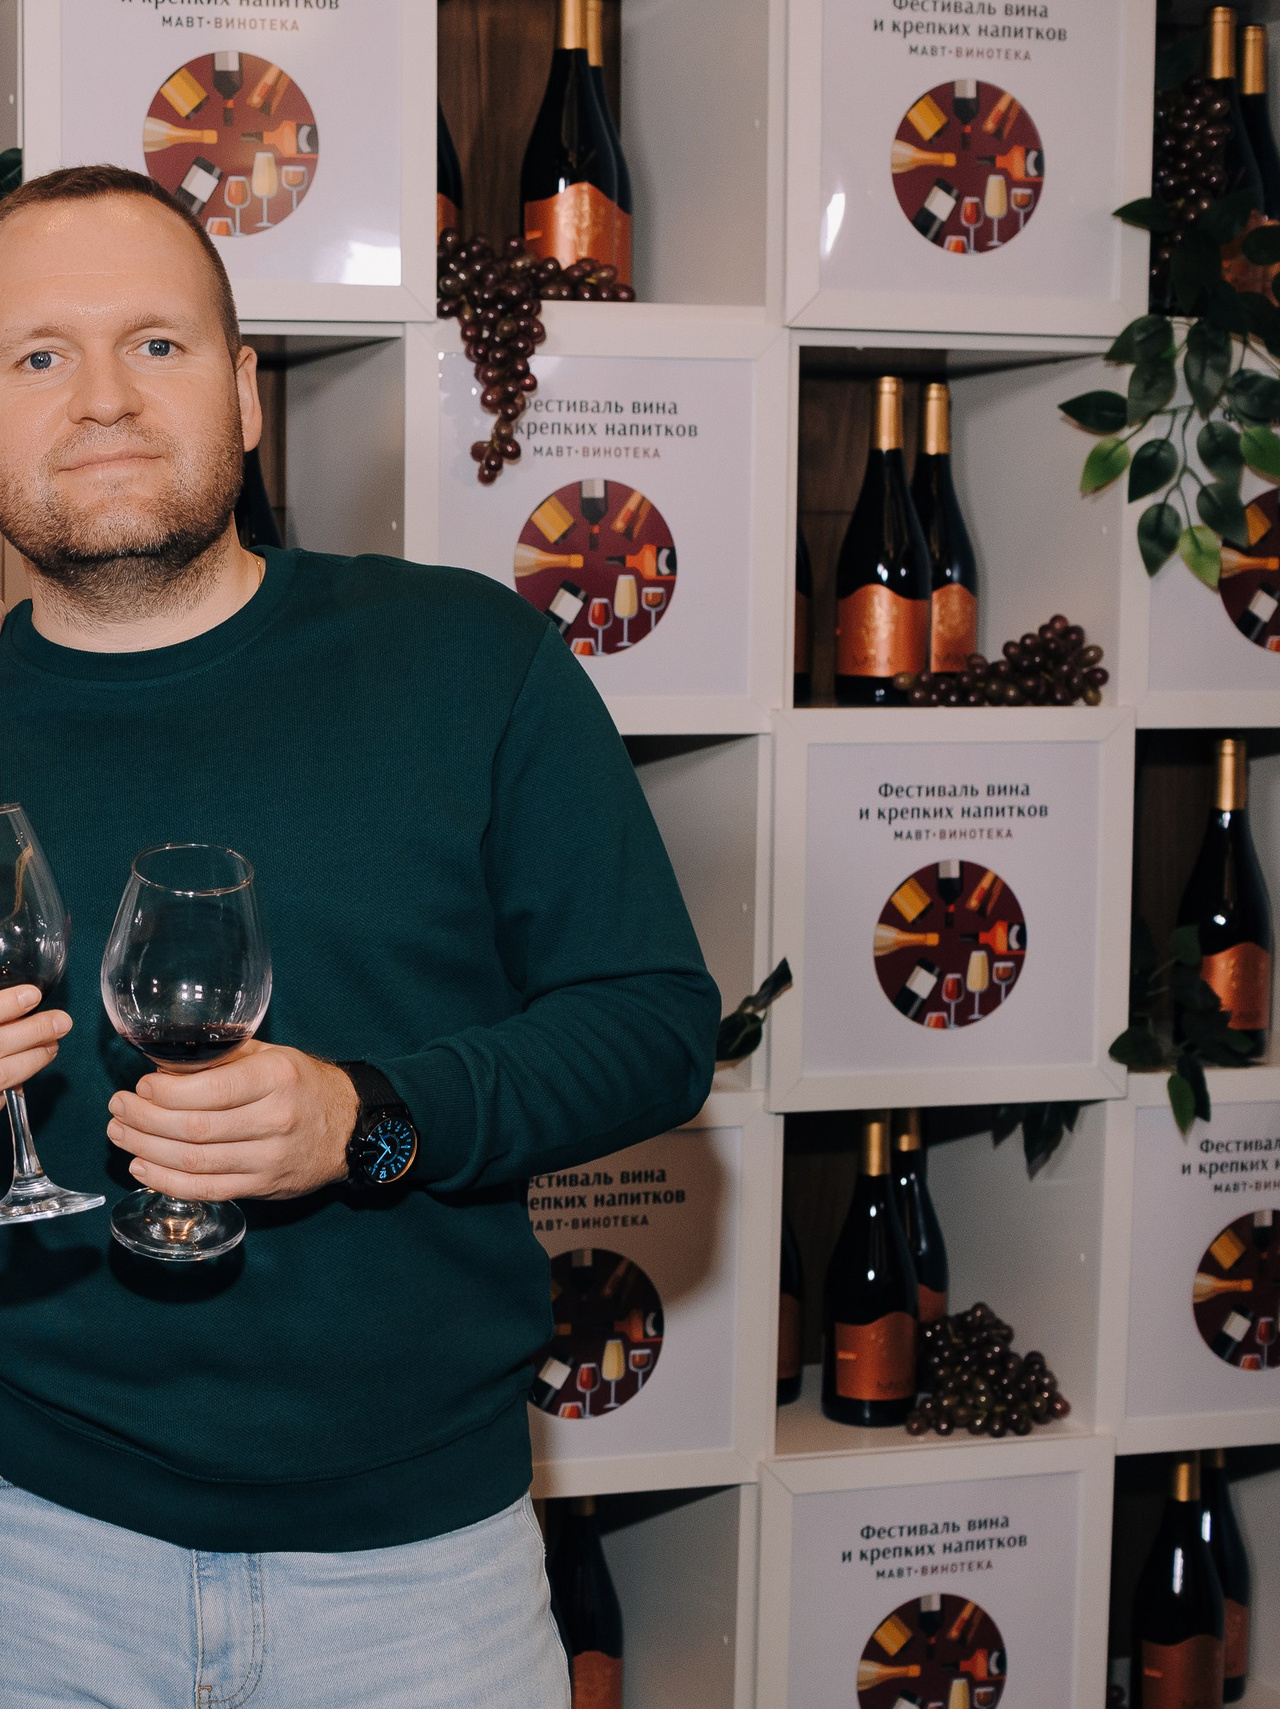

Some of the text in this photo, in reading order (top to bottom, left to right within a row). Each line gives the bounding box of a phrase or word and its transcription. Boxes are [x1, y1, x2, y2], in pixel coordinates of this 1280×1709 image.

[1004, 2, 1049, 18] вина
[873, 19, 1068, 42] и крепких напитков
[631, 400, 679, 415] вина
[605, 423, 699, 438] напитков
[878, 782, 1031, 798] Фестиваль вина
[859, 803, 1049, 825] и крепких напитков
[620, 1168, 667, 1185] вина
[1181, 1163, 1192, 1175] и
[1198, 1159, 1269, 1180] крепких
[529, 1189, 687, 1211] епких напитков
[860, 1515, 1010, 1540] Фестиваль вина
[840, 1535, 1028, 1566] и крепких напитков
